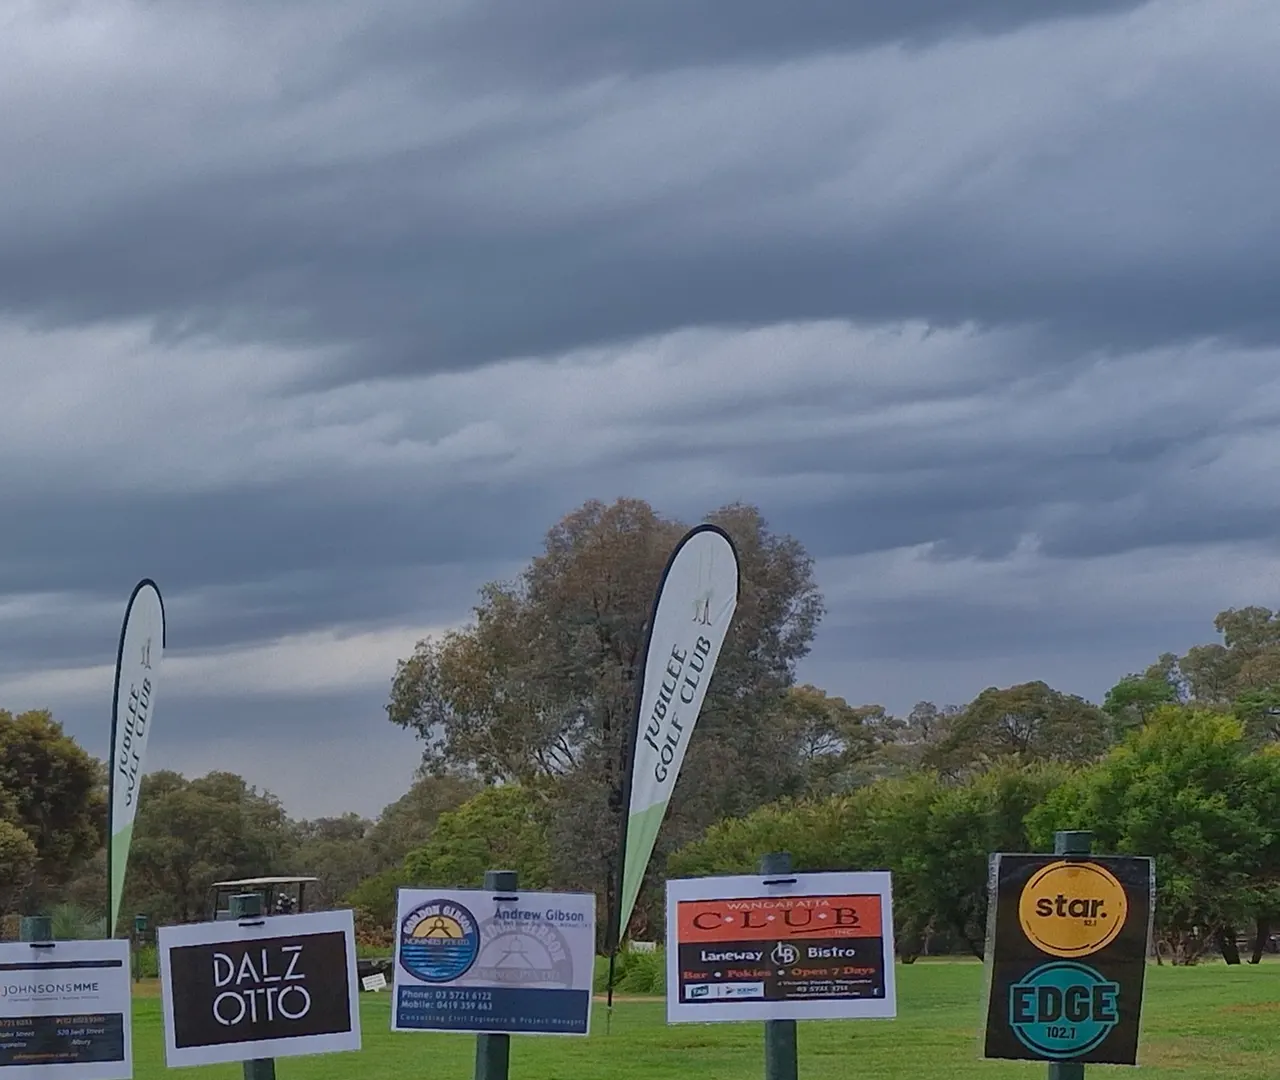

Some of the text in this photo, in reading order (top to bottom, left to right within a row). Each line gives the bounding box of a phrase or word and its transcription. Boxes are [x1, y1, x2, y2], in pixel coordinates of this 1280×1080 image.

[644, 643, 687, 752] JUBILEE
[654, 635, 711, 783] GOLF CLUB
[726, 899, 830, 911] WANGARATTA
[494, 907, 584, 921] Andrew Gibson
[701, 950, 764, 963] Laneway
[808, 947, 856, 958] Bistro
[213, 945, 305, 987] DALZ
[683, 966, 875, 979] Bar Pokies Open 7 Days
[1, 982, 99, 997] JOHNSONSMME
[402, 990, 433, 999] Phone:
[435, 990, 447, 999] 03
[448, 991, 470, 999] 5721
[213, 985, 311, 1026] OTTO
[401, 1000, 434, 1009] Mobile:
[1013, 985, 1117, 1024] EDGE
[1047, 1026, 1076, 1039] 102.1
